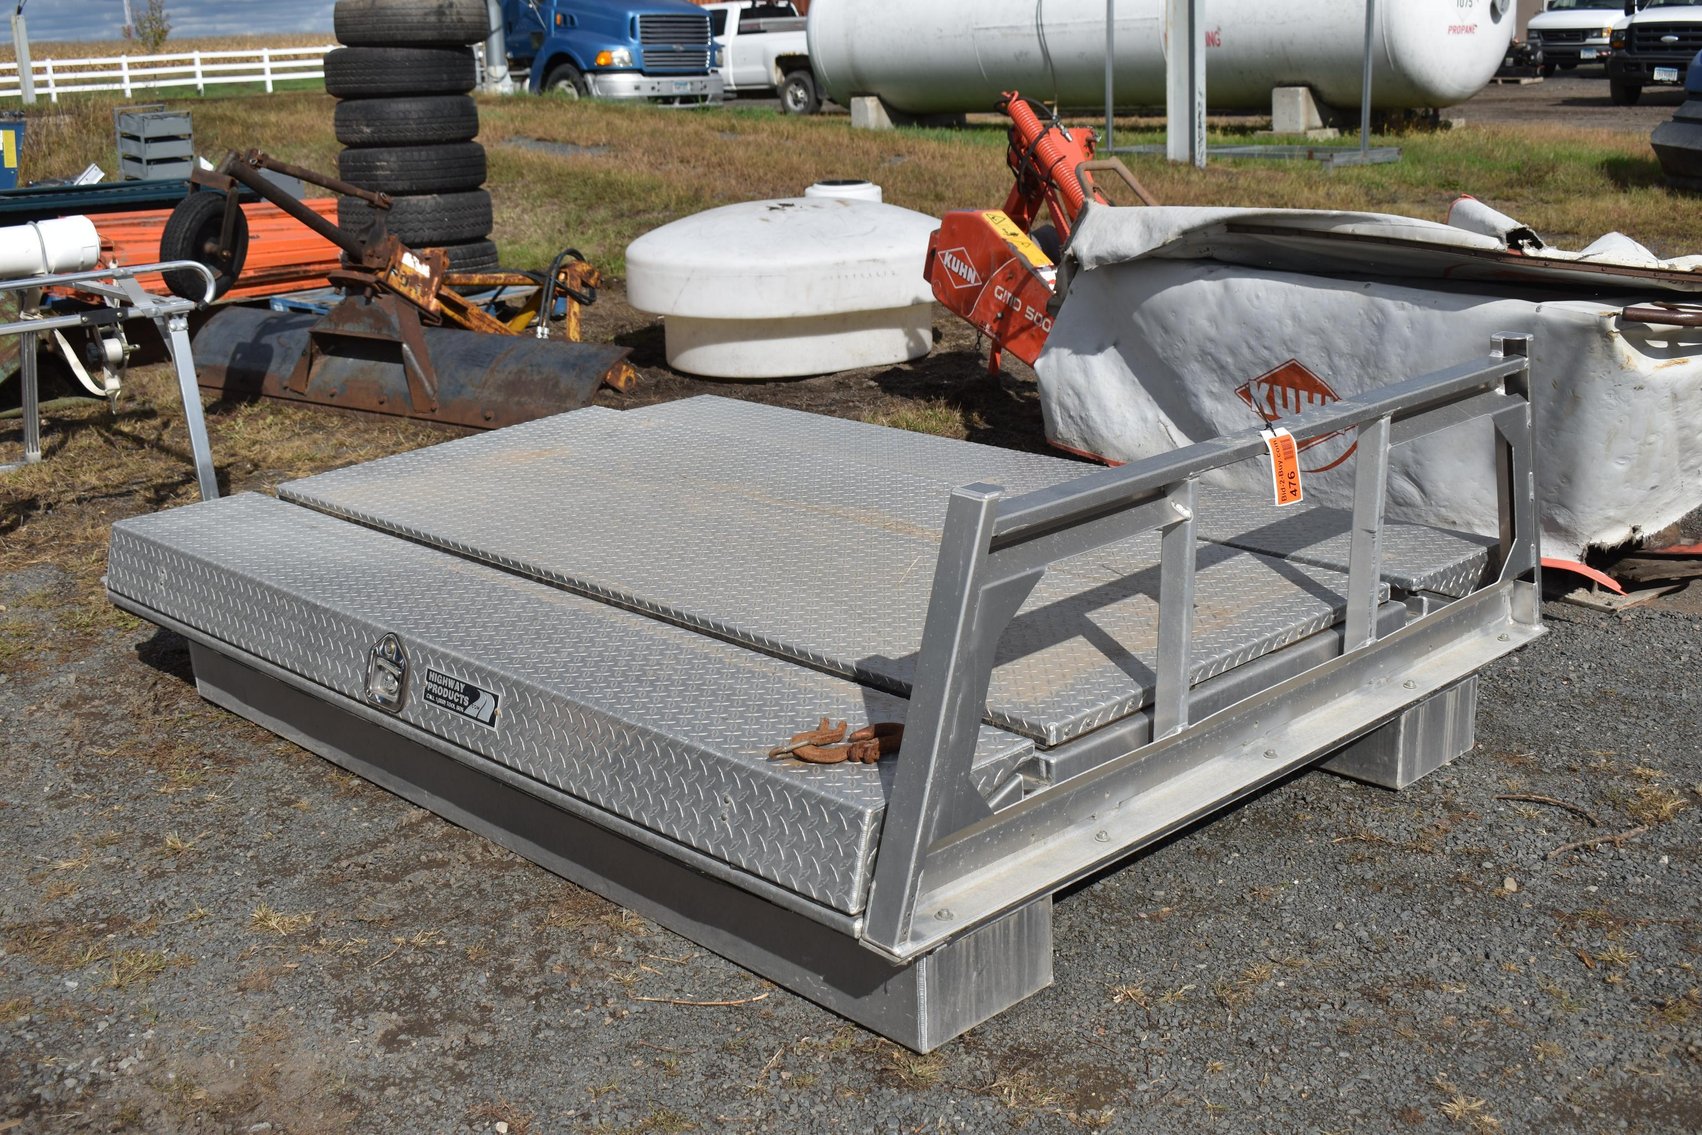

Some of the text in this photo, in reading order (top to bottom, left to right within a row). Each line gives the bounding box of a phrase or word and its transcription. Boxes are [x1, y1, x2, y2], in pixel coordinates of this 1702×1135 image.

[1448, 24, 1476, 35] PROPANE
[943, 251, 978, 285] KUHN
[994, 285, 1052, 333] GMD 500
[1273, 440, 1287, 502] Bid-2-Buy.com
[1287, 470, 1298, 497] 476
[427, 682, 470, 706] PRODUCTS
[428, 671, 466, 693] HIGHWAY
